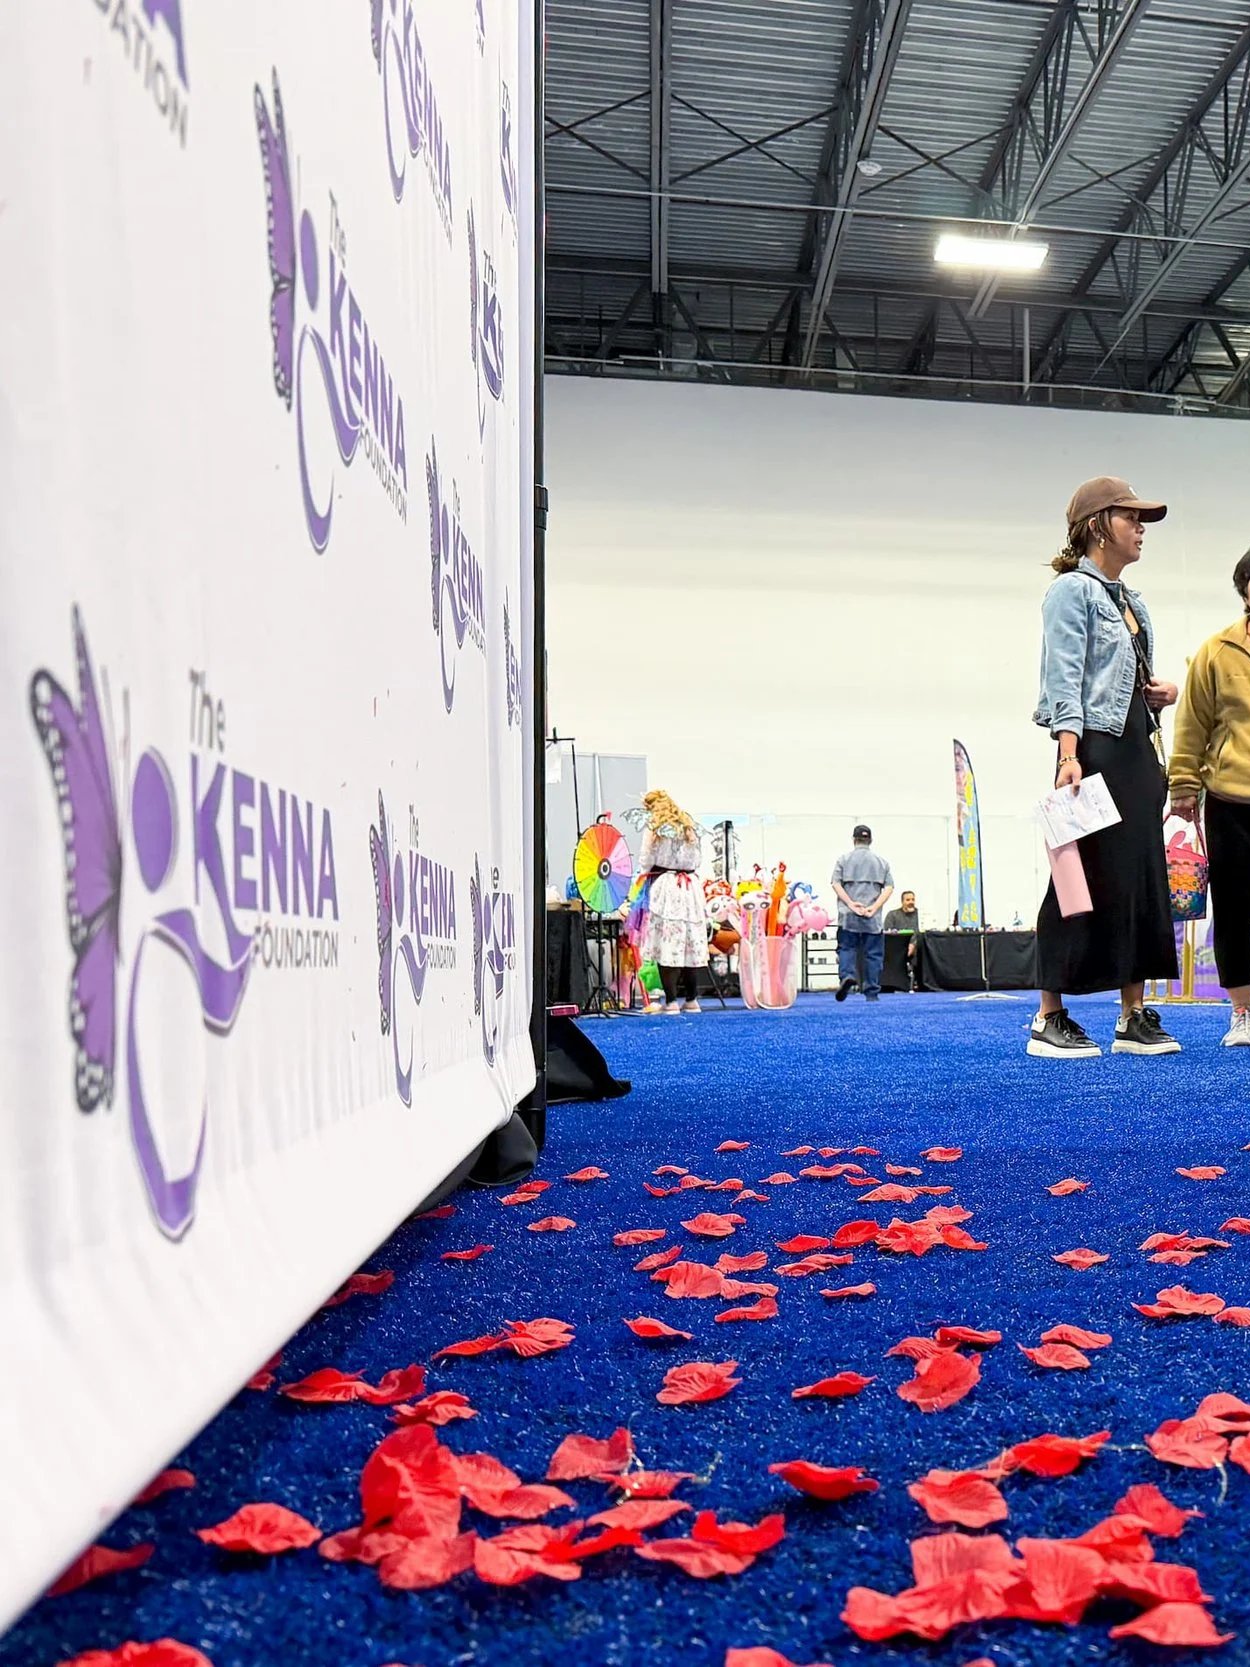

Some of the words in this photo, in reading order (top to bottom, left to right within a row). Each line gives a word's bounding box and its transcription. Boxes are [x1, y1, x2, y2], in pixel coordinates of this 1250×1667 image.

[94, 0, 189, 149] ATION
[329, 187, 347, 269] The
[329, 245, 408, 492] KENNA
[360, 416, 407, 526] FOUNDATION
[189, 668, 226, 753] The
[190, 752, 339, 940] KENNA
[409, 849, 457, 941] KENNA
[252, 920, 339, 970] FOUNDATION
